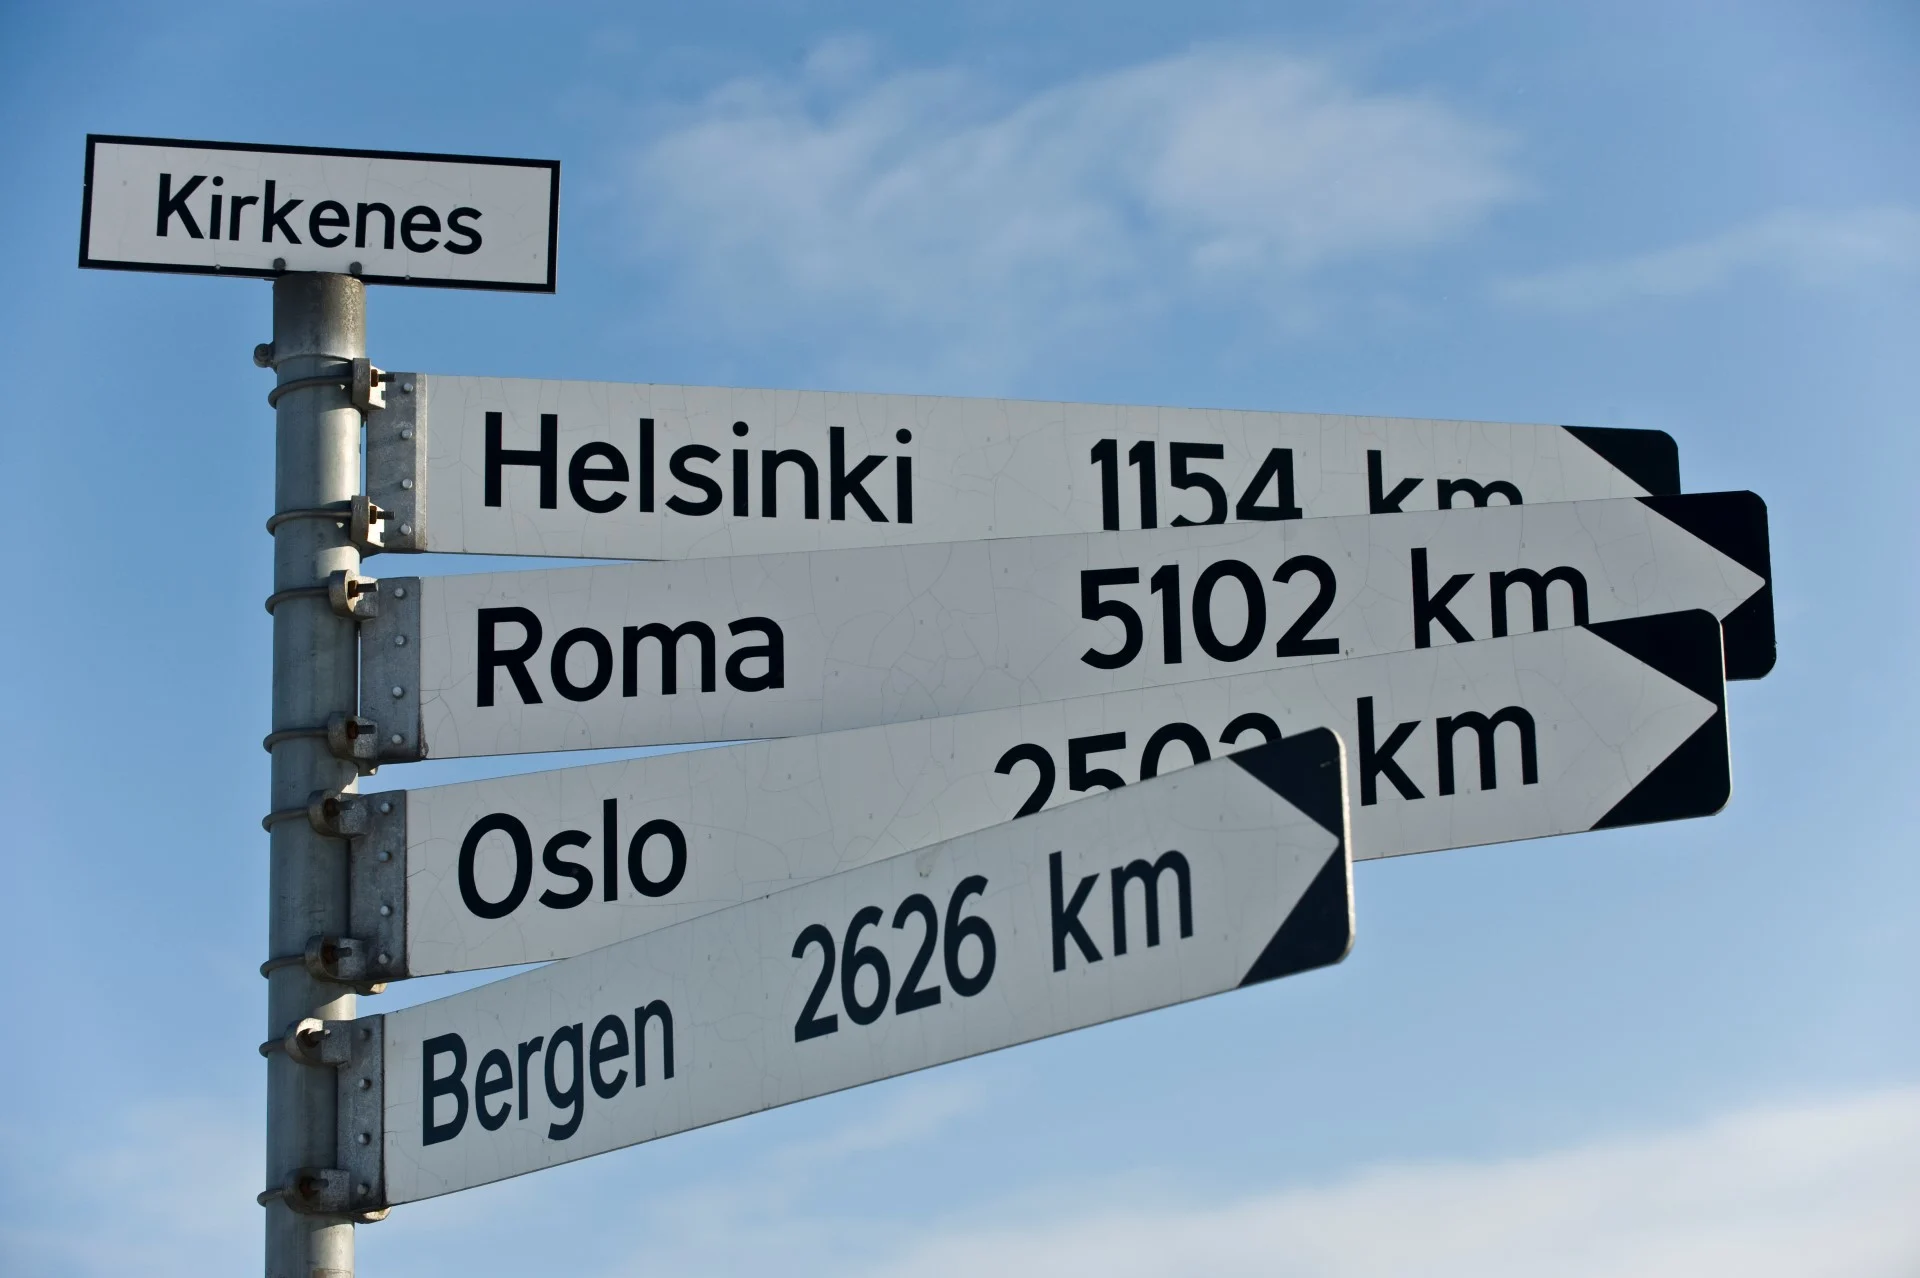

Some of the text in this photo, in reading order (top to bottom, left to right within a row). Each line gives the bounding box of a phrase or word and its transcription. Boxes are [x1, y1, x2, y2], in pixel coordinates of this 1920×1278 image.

[157, 173, 482, 254] Kirkenes
[485, 412, 912, 523] Helsinki
[1091, 439, 1302, 531] 1154
[477, 548, 1588, 707] Roma 5102 km
[458, 696, 1538, 919] Oslo 25 km
[423, 850, 1194, 1146] Bergen 2626 km
